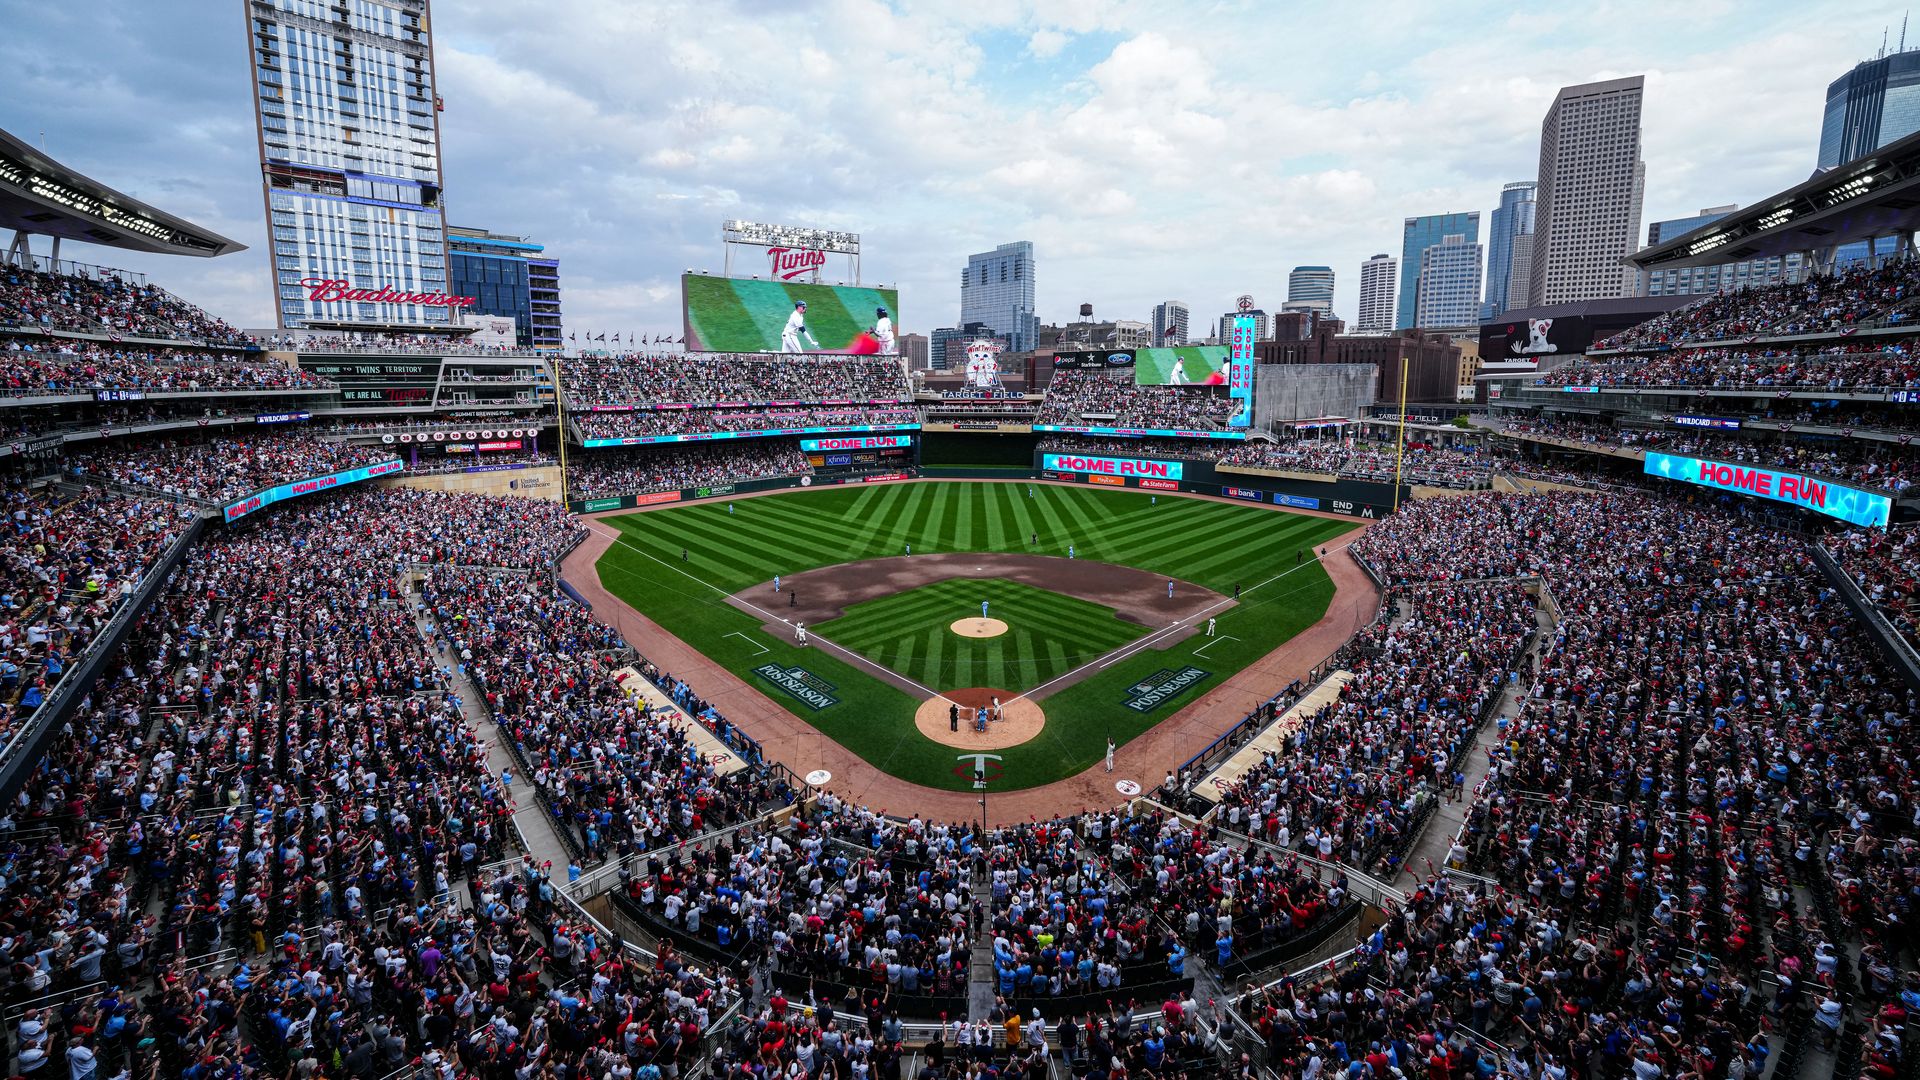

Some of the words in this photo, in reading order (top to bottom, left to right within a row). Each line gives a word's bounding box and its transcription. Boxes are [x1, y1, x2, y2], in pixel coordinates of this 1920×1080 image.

[768, 246, 826, 276] Twins
[301, 277, 476, 307] Budweiser
[1232, 327, 1242, 359] HOME
[1232, 365, 1240, 388] RUN
[818, 439, 862, 449] HOME
[866, 436, 896, 446] RUN
[368, 465, 386, 476] HOME
[388, 462, 400, 472] RUN
[828, 455, 850, 464] xfinity
[1058, 457, 1114, 472] HOME
[1120, 460, 1167, 476] RUN
[292, 482, 317, 494] HOME
[320, 477, 336, 488] RUN
[1700, 462, 1772, 495] HOME
[1778, 476, 1827, 508] RUN
[228, 502, 246, 518] HOME
[248, 497, 260, 509] RUN
[1333, 501, 1353, 510] END
[758, 665, 833, 708] POSTSEASON
[1129, 668, 1204, 710] POSTSEASON
